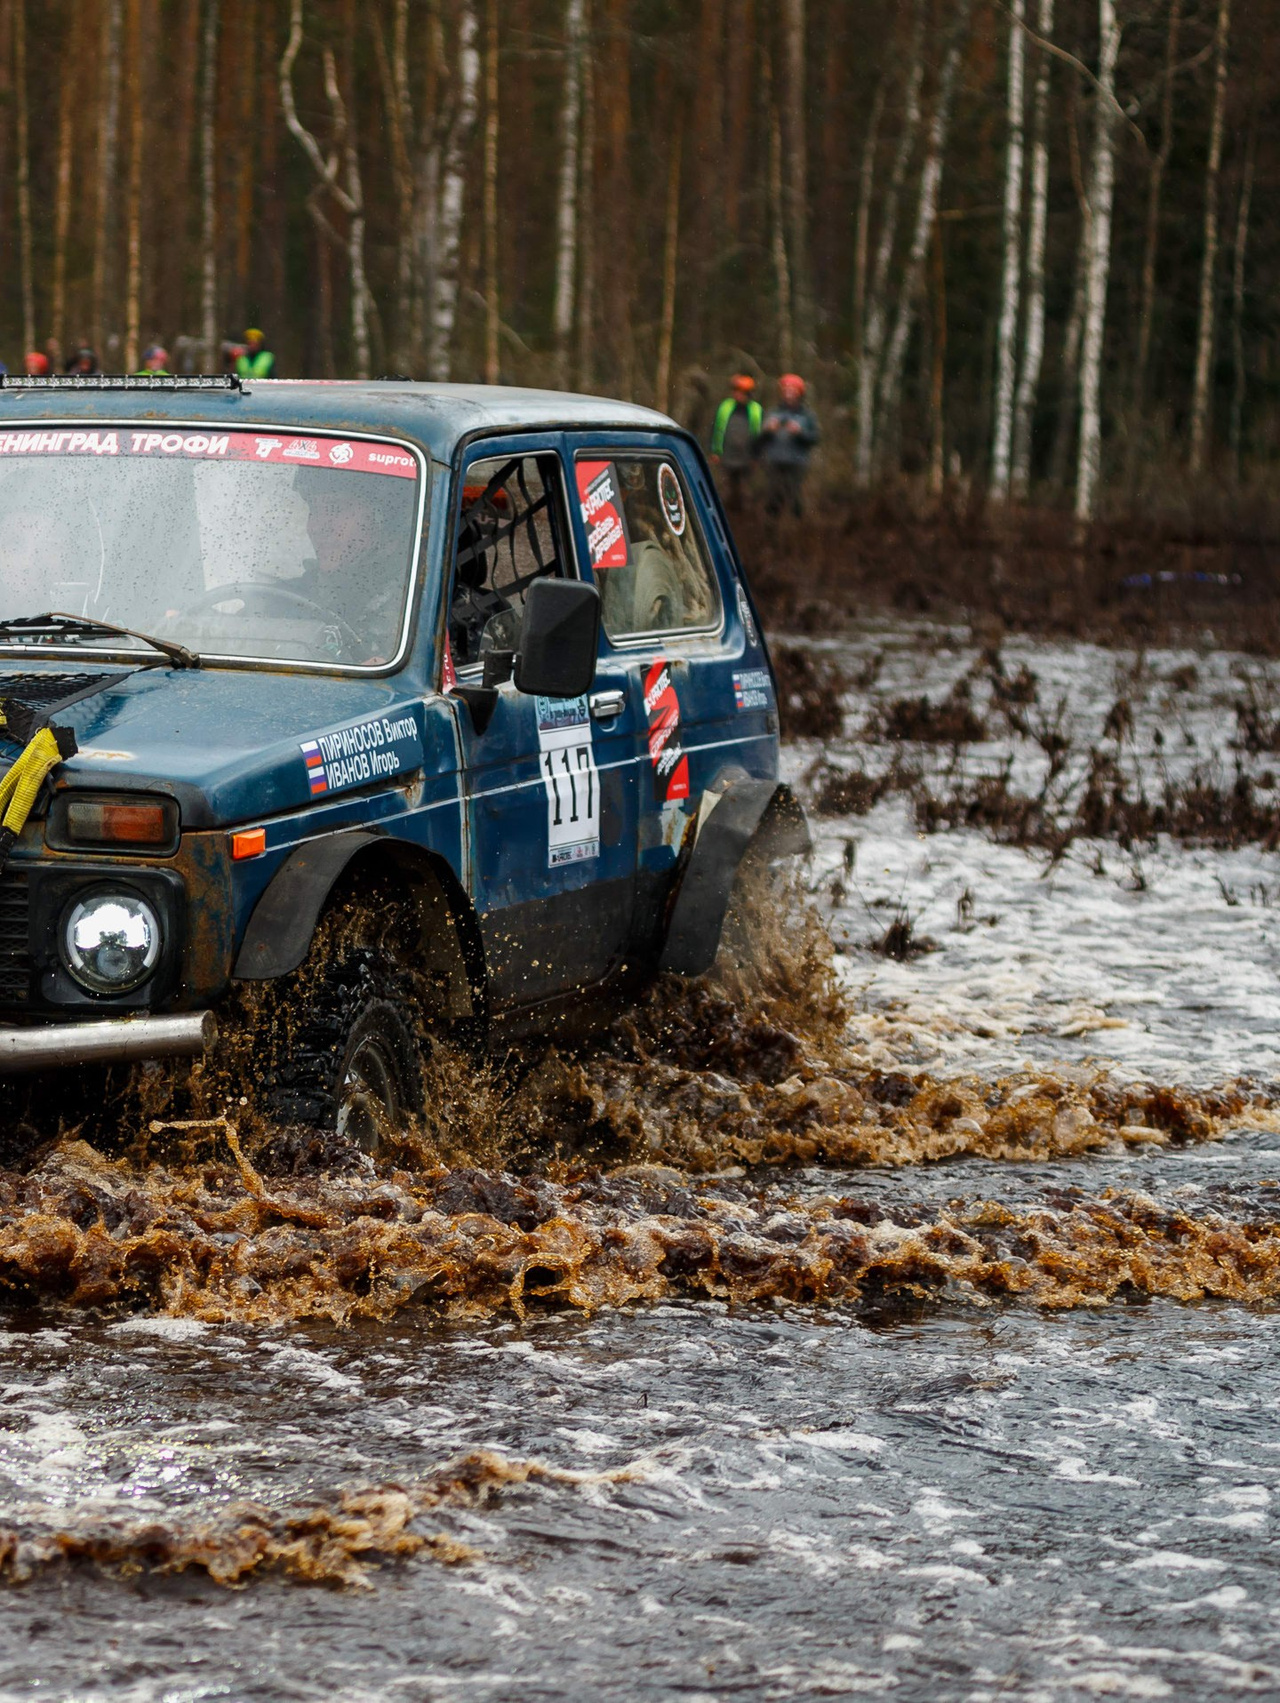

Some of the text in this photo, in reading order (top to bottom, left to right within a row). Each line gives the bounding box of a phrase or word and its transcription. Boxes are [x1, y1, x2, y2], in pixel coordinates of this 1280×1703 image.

[130, 433, 229, 455] ТРОФИ
[368, 452, 417, 467] suprot
[318, 716, 417, 763] ПИРИНОСОВ Виктор
[325, 749, 400, 790] ИВАНОВ Игорь
[545, 747, 593, 826] 117
